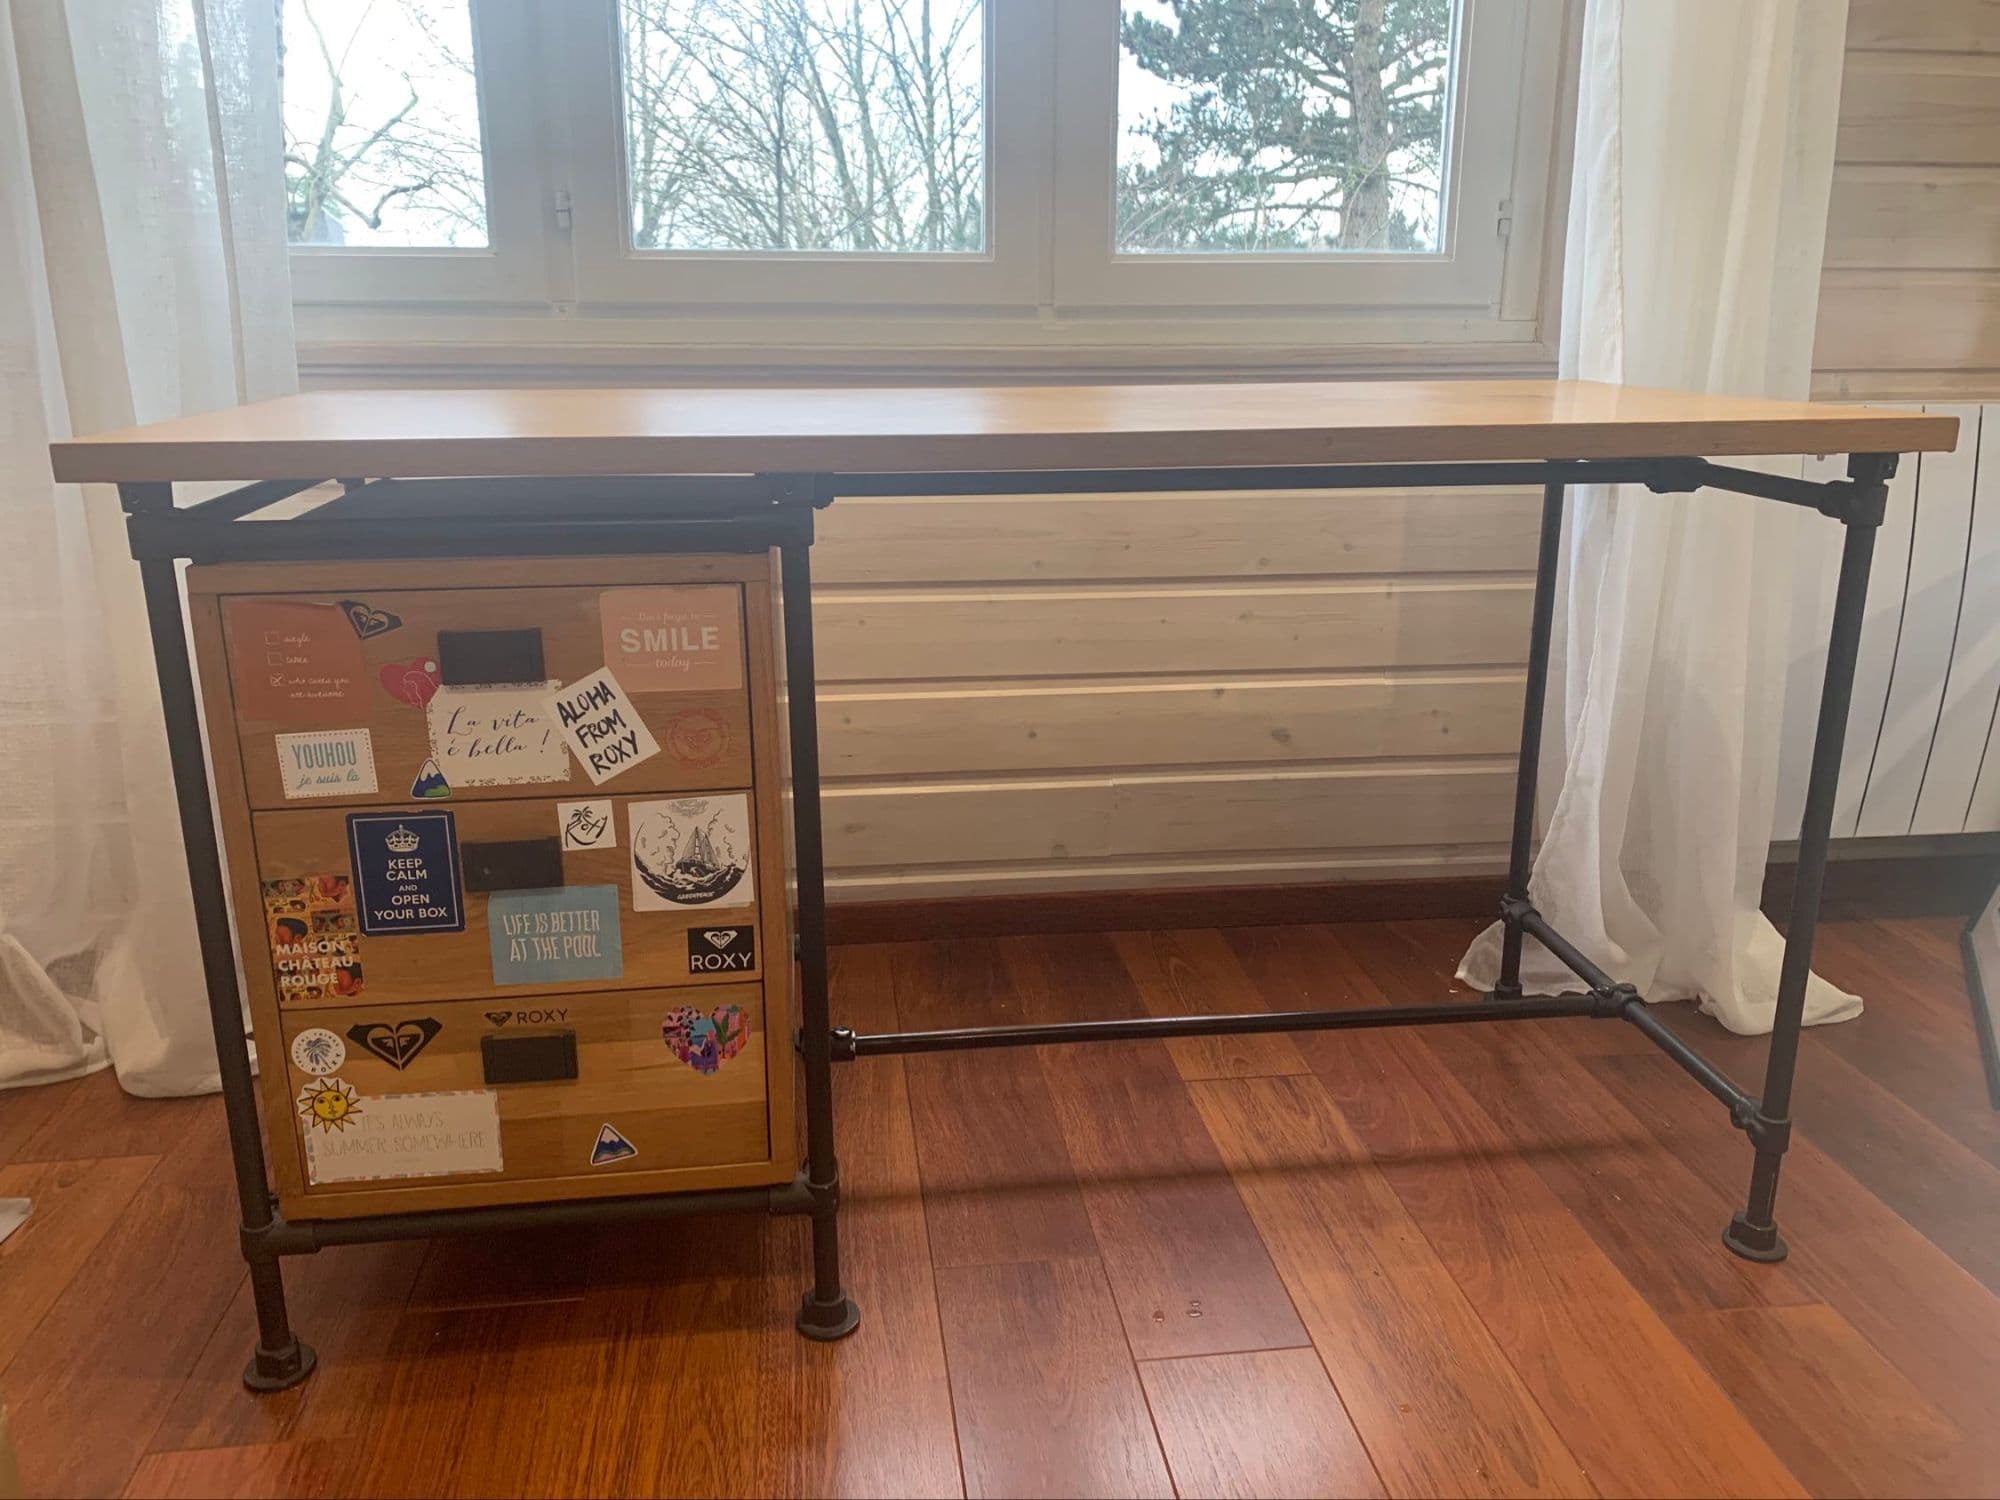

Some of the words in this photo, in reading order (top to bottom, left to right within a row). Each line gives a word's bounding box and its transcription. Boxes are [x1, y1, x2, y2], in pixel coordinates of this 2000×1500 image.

[620, 626, 720, 653] SMILE
[655, 656, 690, 671] today
[557, 680, 616, 727] ALOHA
[447, 706, 481, 736] La
[492, 709, 540, 732] vita
[575, 709, 627, 749] FROM
[291, 741, 356, 769] YOUHOU
[589, 730, 639, 775] ROXY
[296, 772, 312, 789] je
[316, 773, 342, 784] suis
[388, 858, 423, 869] KEEP
[386, 869, 428, 881] CALM
[399, 884, 418, 892] AND
[391, 894, 430, 905] OPEN
[374, 909, 414, 921] YOUR
[418, 907, 448, 919] BOX
[503, 913, 531, 935] LIFE
[535, 912, 549, 932] IS
[551, 910, 600, 932] BETTER
[276, 940, 345, 956] MAISON
[510, 939, 528, 962] AT
[534, 937, 560, 961] THE
[564, 935, 601, 958] POOL
[278, 954, 354, 972] CHÂTEAU
[691, 952, 752, 971] ROXY
[280, 972, 338, 988] ROUGE
[517, 1008, 568, 1025] ROXY
[392, 1111, 444, 1129] ALWAYS
